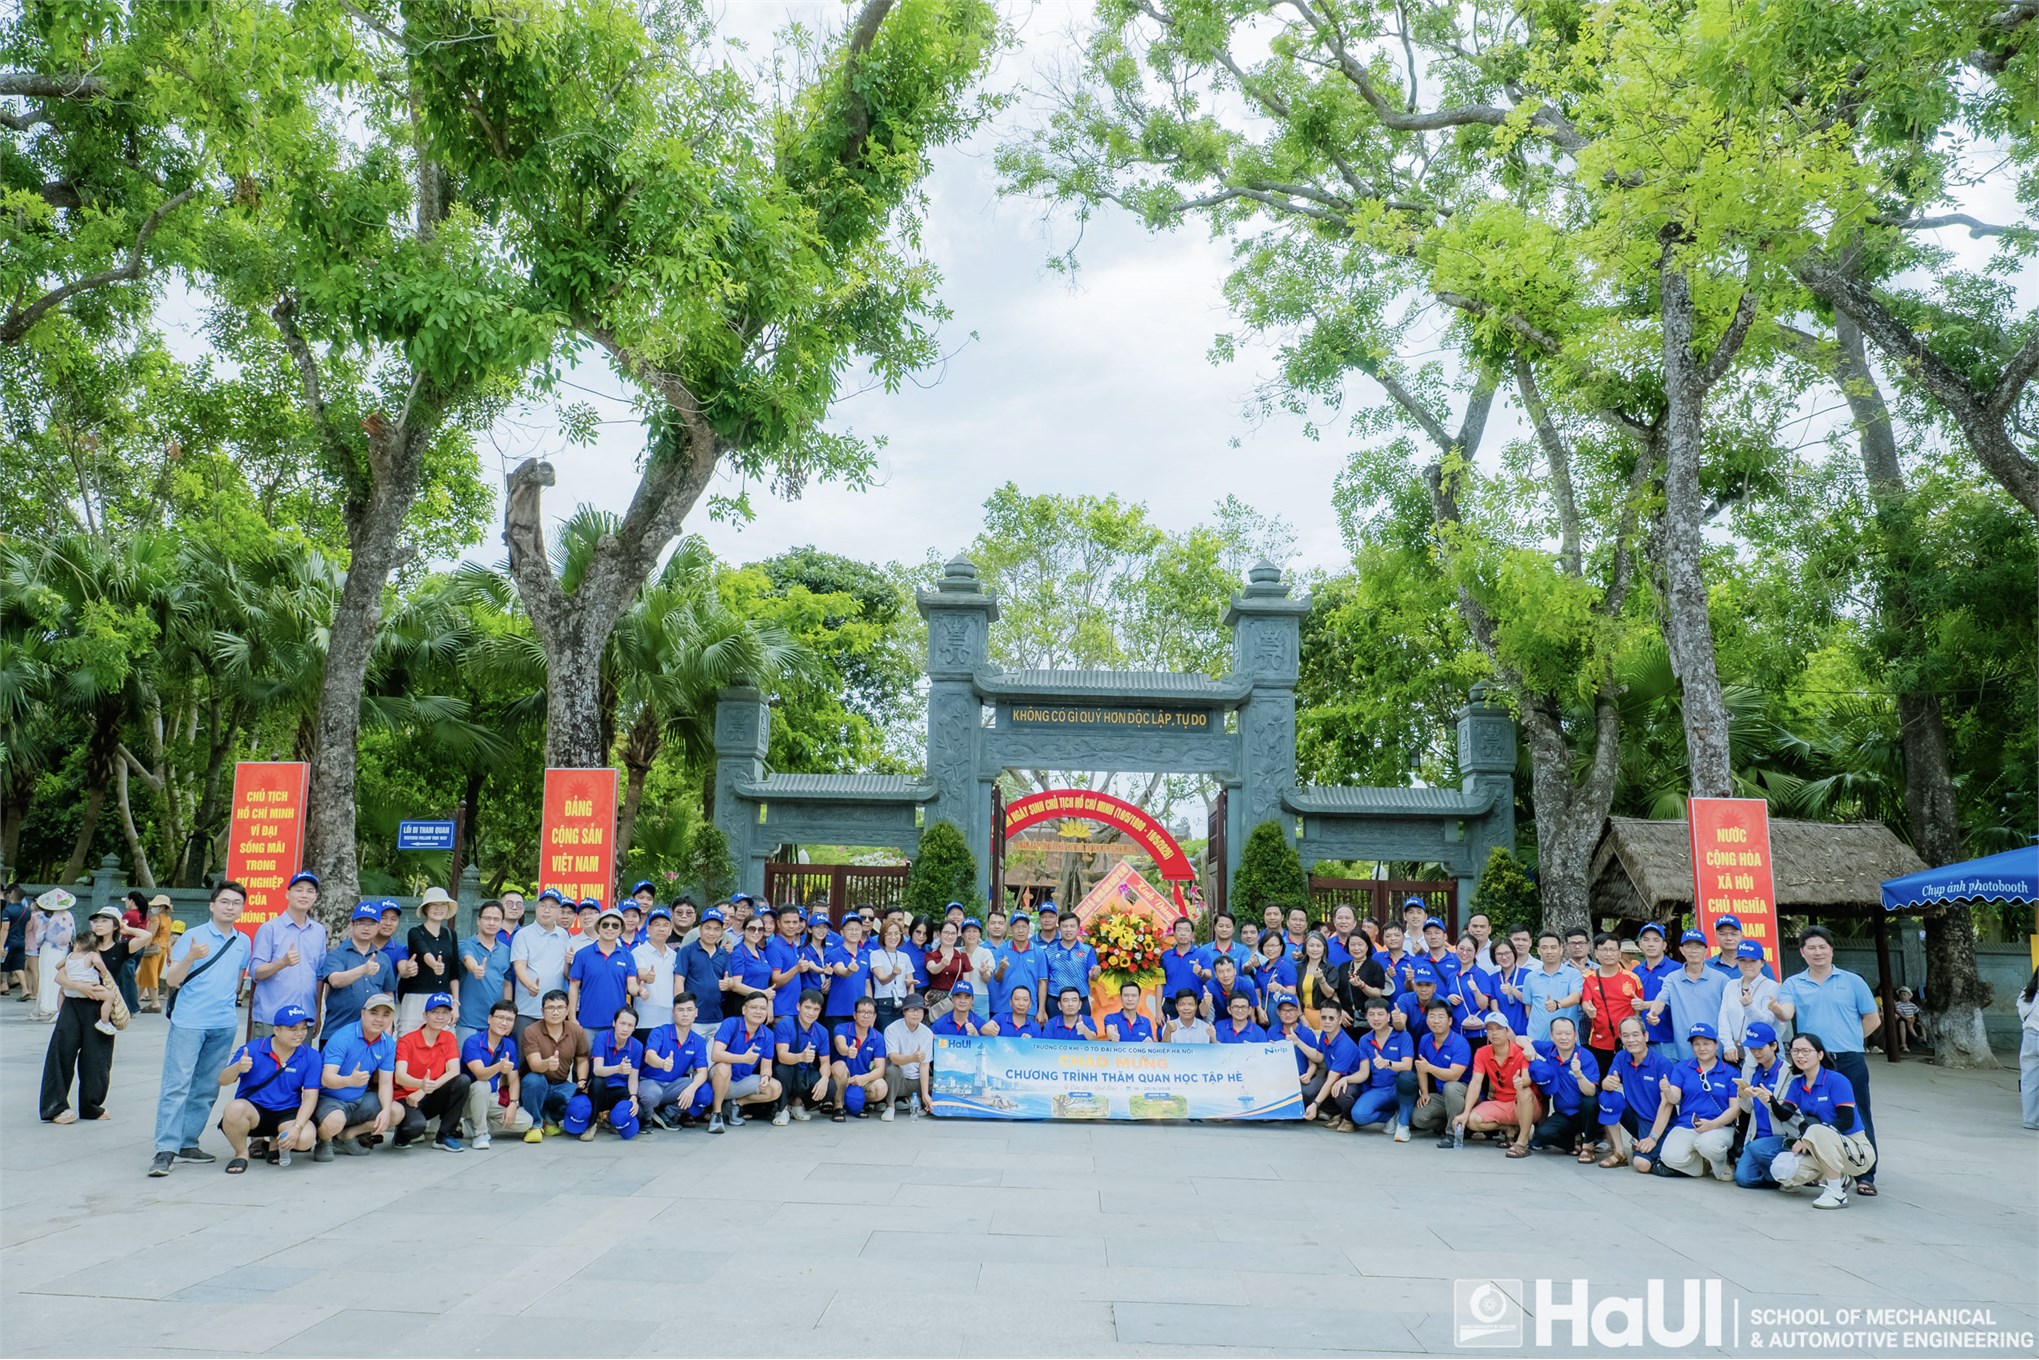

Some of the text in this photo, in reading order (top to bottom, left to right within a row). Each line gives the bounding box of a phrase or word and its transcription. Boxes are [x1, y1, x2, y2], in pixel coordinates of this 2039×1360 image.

[1013, 706, 1050, 722] KHÔNG
[1052, 707, 1066, 723] CÓ
[1067, 707, 1078, 723] GÌ
[1080, 709, 1102, 724] QUÝ
[1104, 711, 1126, 724] HƠN
[1127, 709, 1150, 727] ĐỘC
[1176, 713, 1191, 729] TỰ
[1192, 714, 1206, 726] DO
[247, 788, 288, 804] CHỦ TỊCH
[237, 807, 294, 819] HỒ CHÍ MINH
[565, 795, 592, 817] ĐẢNG
[1010, 806, 1029, 823] NGÀY
[1028, 801, 1045, 815] SINH
[1045, 794, 1059, 811] CHỦ
[1059, 797, 1074, 811] TỊCH
[1084, 798, 1097, 810] CHÍ
[1096, 800, 1115, 816] MINH
[251, 824, 277, 838] VĨ ĐẠI
[552, 823, 602, 847] CỘNG SẢN
[1717, 826, 1747, 843] NƯỚC
[240, 840, 285, 853] SỐNG MÃI
[246, 860, 276, 870] TRONG
[552, 852, 599, 875] VIỆT NAM
[1706, 849, 1762, 868] CỘNG HÒA
[250, 876, 283, 890] NGHIỆP
[1718, 873, 1754, 893] XÃ HỘI
[1922, 884, 1945, 897] Chụp
[1968, 879, 2029, 894] photobooth
[249, 892, 267, 905] CỦA
[580, 884, 604, 900] VINH
[1708, 895, 1767, 914] CHỦ NGHĨA
[1739, 943, 1754, 951] Ntrip
[948, 1039, 971, 1048] HaUI
[1006, 1068, 1243, 1085] CHƯƠNG TRÌNH THĂM QUAN HỌC TẬP HÈ
